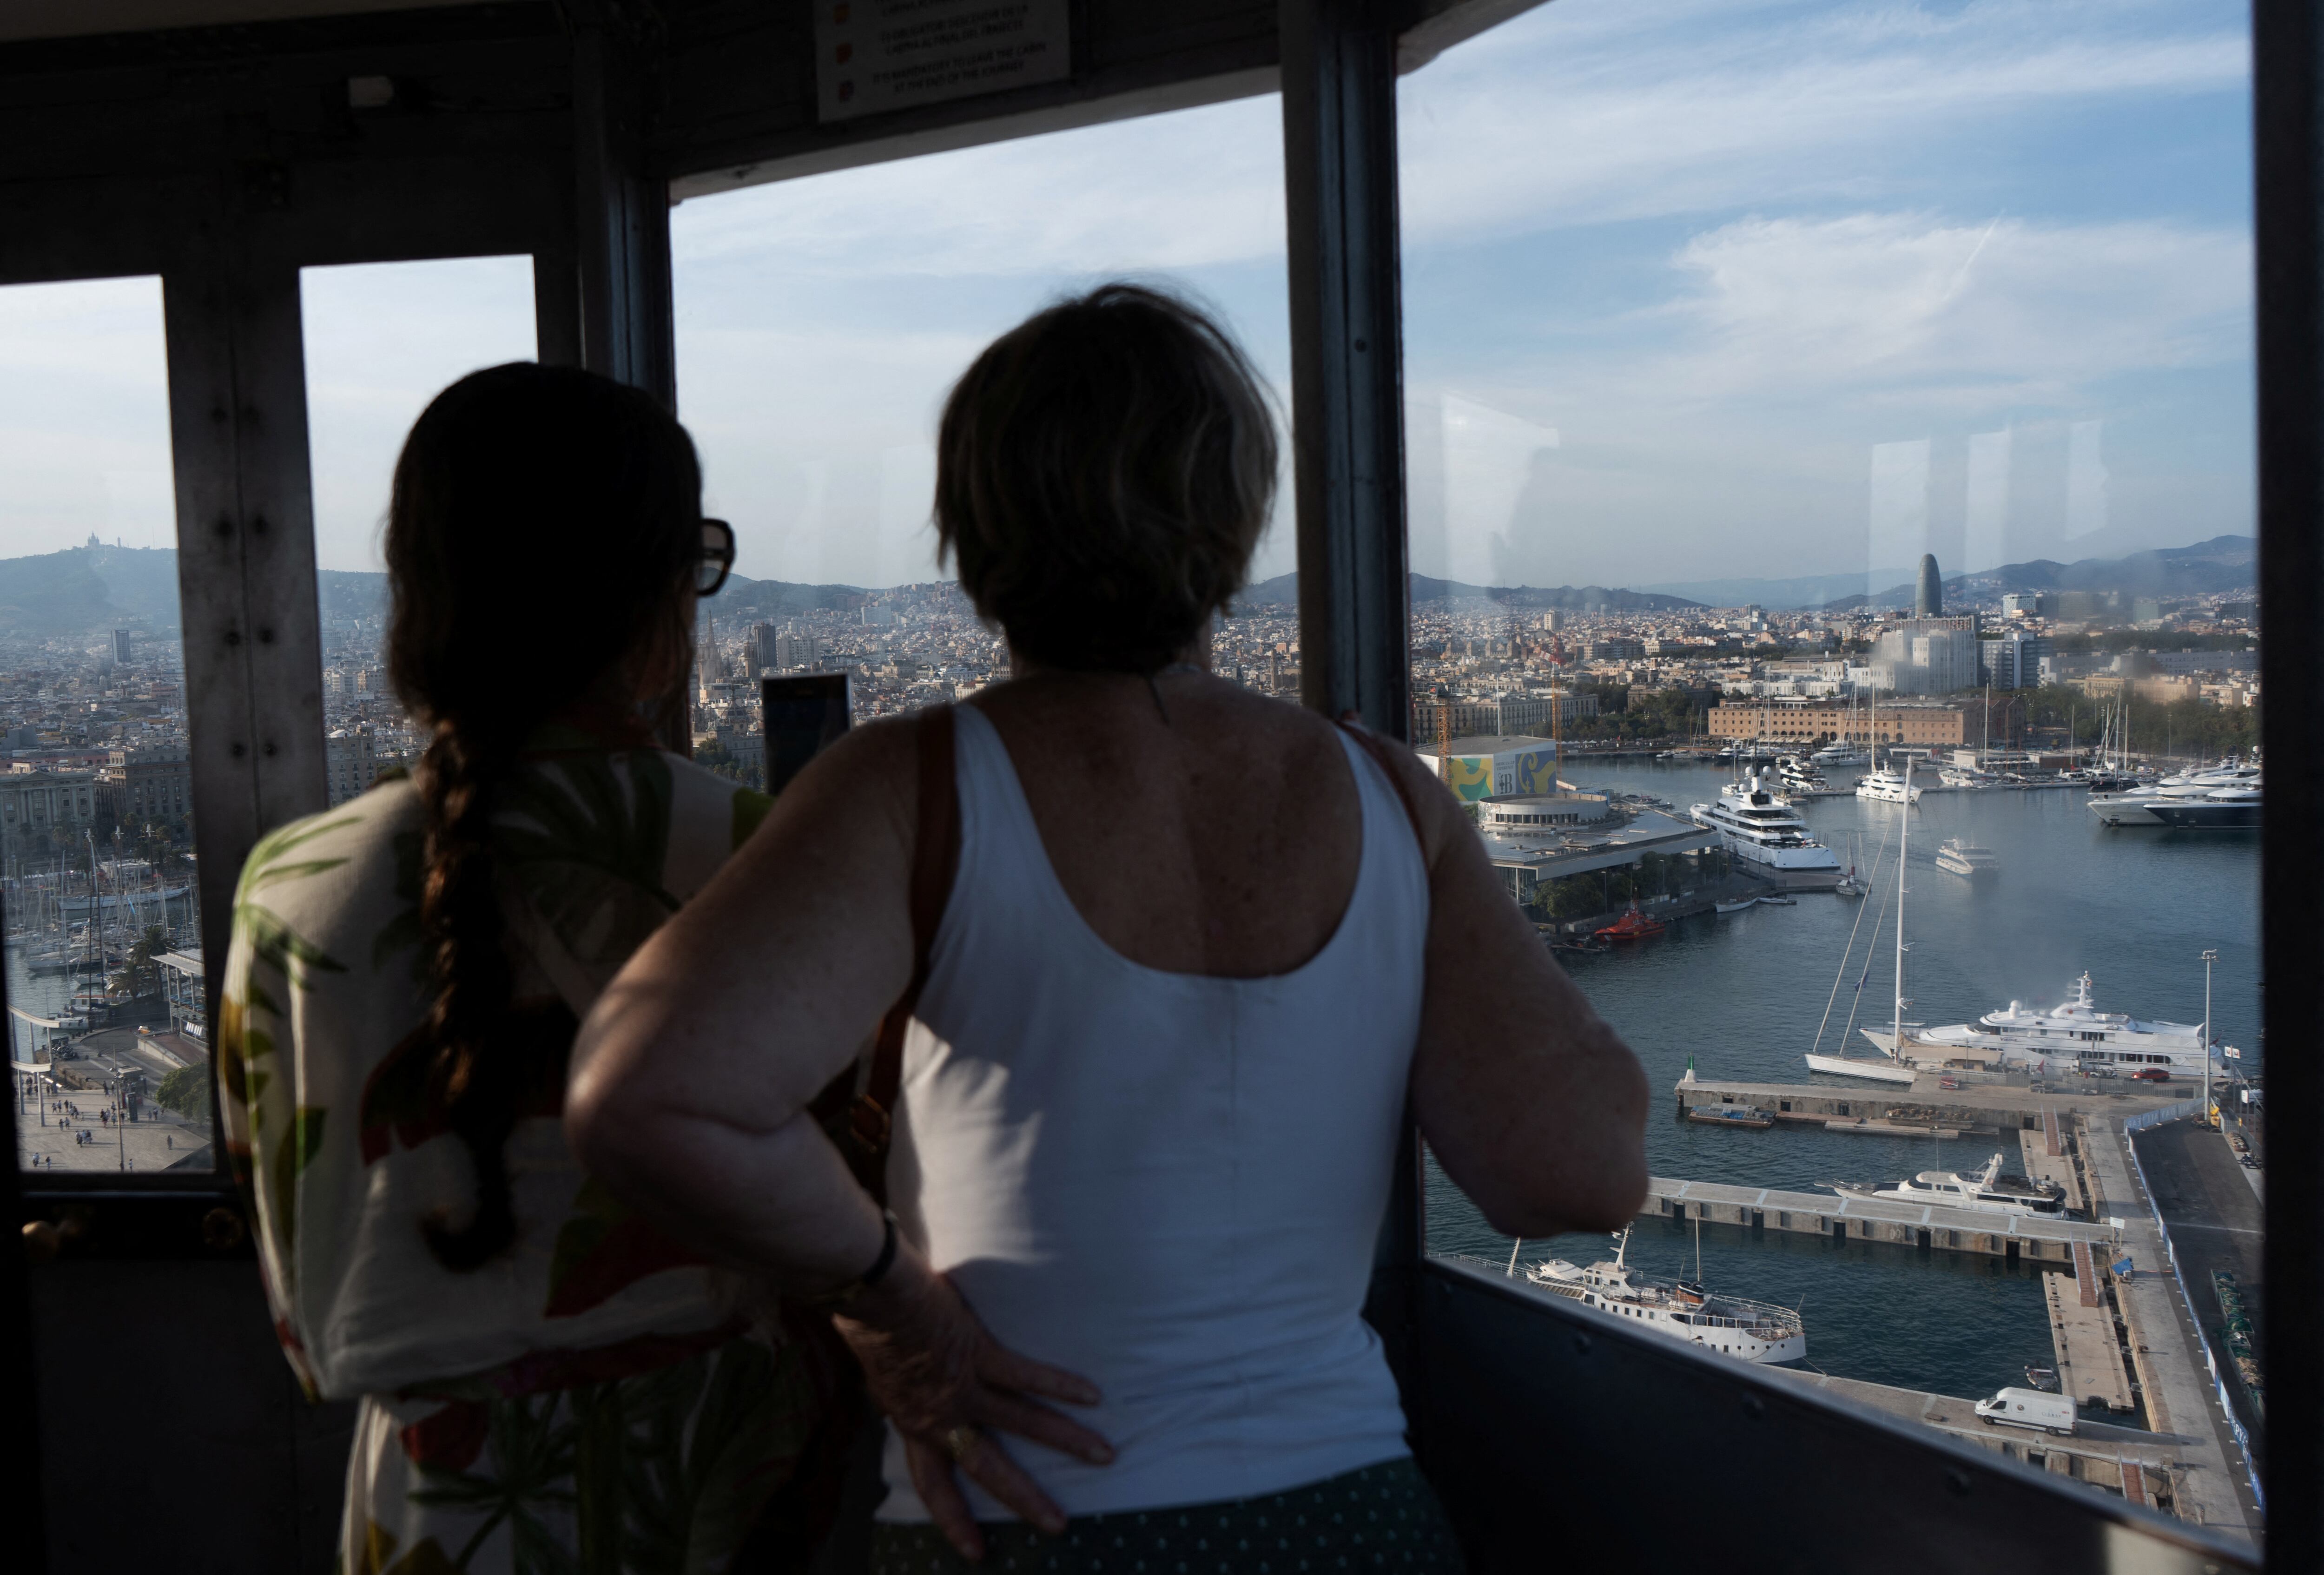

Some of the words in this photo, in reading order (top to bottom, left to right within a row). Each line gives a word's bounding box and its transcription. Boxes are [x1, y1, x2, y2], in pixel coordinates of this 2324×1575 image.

[1003, 7, 1014, 18] DE
[962, 28, 978, 40] DEL
[872, 73, 880, 84] IT
[882, 72, 890, 83] IS
[891, 60, 950, 80] MANDATORY
[953, 56, 965, 68] TO
[966, 49, 993, 66] LEAVE
[996, 47, 1013, 59] THE
[1016, 41, 1046, 57] CABIN
[894, 81, 905, 93] AT
[907, 79, 923, 91] THE
[925, 74, 945, 88] END
[947, 71, 959, 85] OF
[962, 69, 978, 81] THE
[982, 60, 1024, 78] JOURNEY
